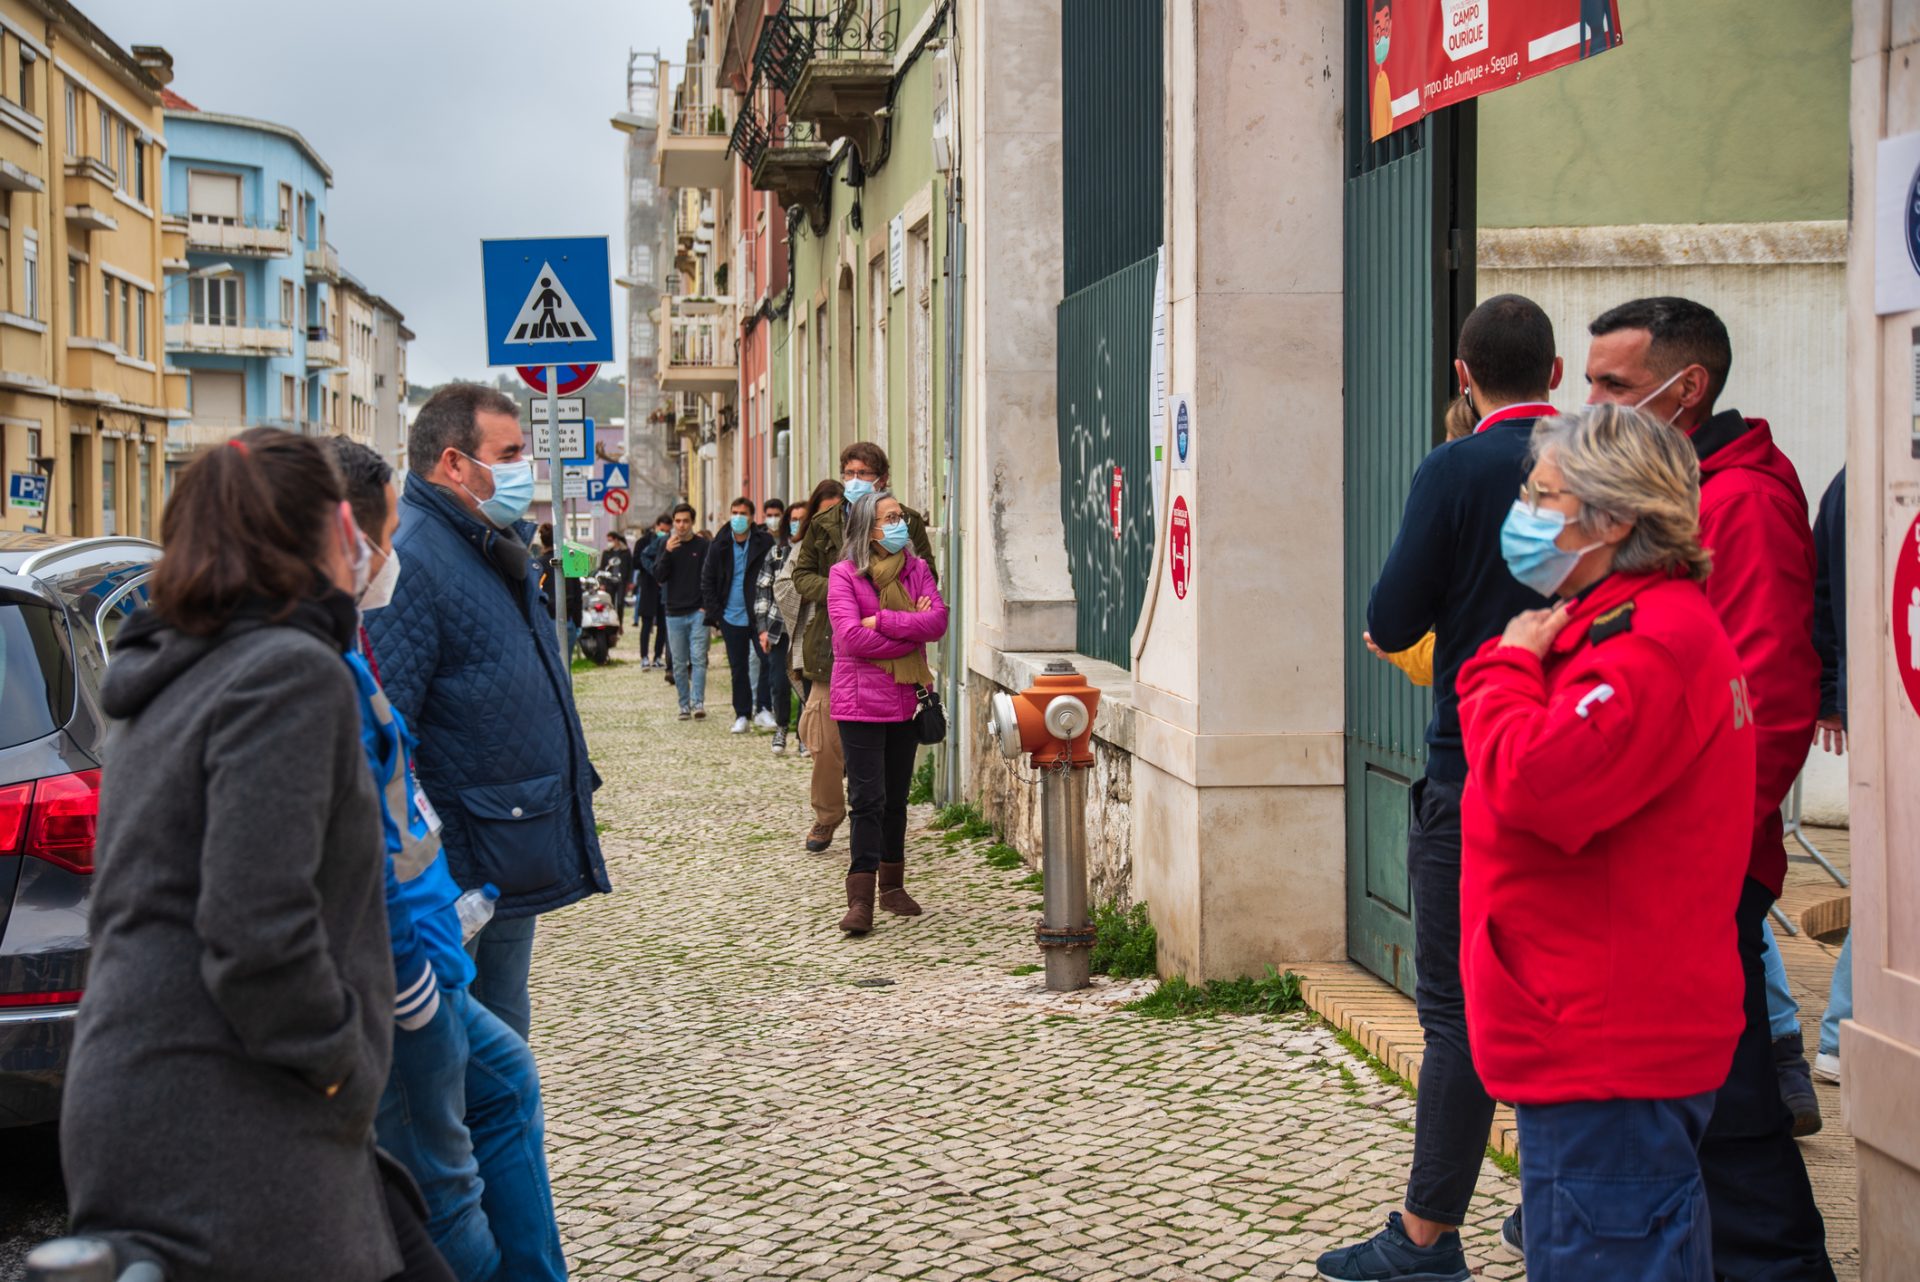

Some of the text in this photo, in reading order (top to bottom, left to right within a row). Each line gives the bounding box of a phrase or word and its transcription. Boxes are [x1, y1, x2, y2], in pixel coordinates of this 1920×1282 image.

[1452, 4, 1479, 27] CAMPO
[1448, 24, 1484, 51] OURIQUE
[1443, 73, 1453, 91] de
[1454, 65, 1483, 85] Ourique
[1484, 66, 1490, 74] +
[1490, 52, 1519, 74] Segura
[19, 477, 35, 497] P
[590, 481, 604, 499] P
